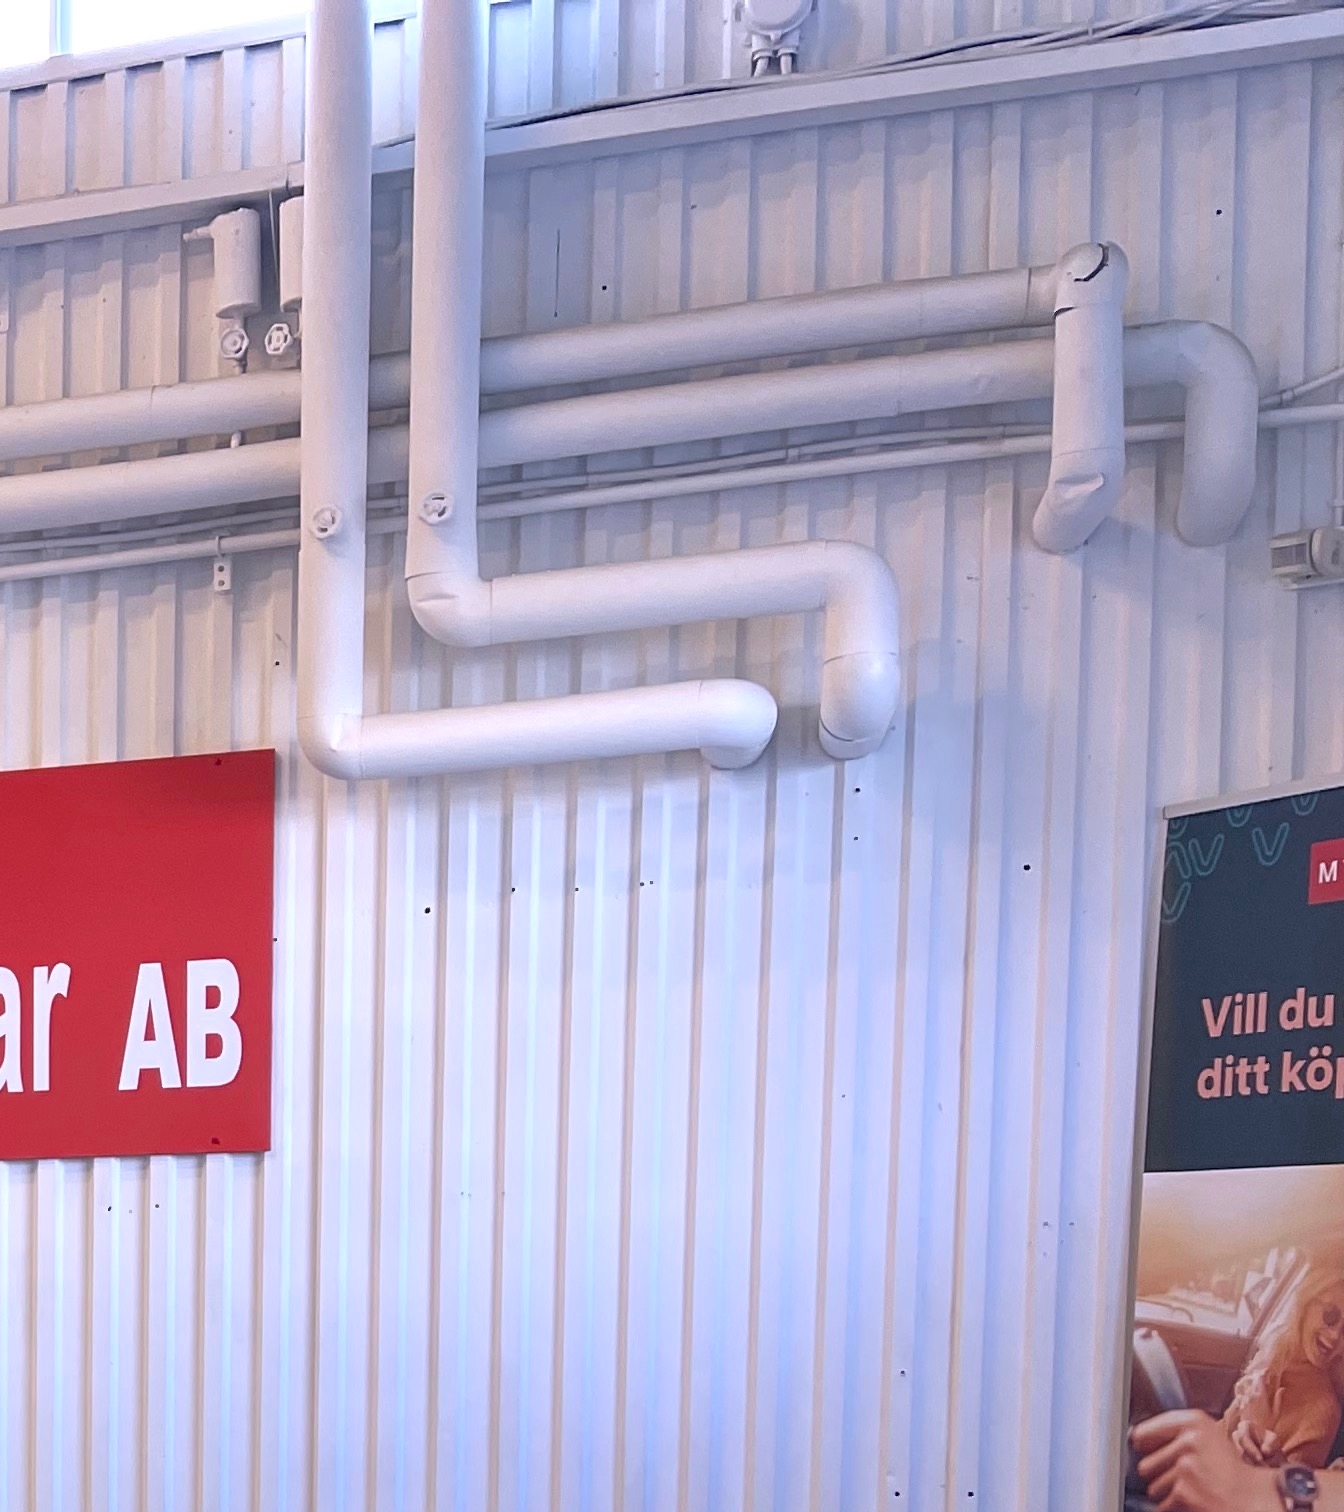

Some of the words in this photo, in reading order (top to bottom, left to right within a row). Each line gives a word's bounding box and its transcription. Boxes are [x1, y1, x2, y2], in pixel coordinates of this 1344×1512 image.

[1319, 860, 1344, 884] M
[118, 956, 245, 1093] AB
[1201, 991, 1268, 1038] Vill
[1279, 987, 1334, 1031] du
[1197, 1055, 1270, 1100] ditt
